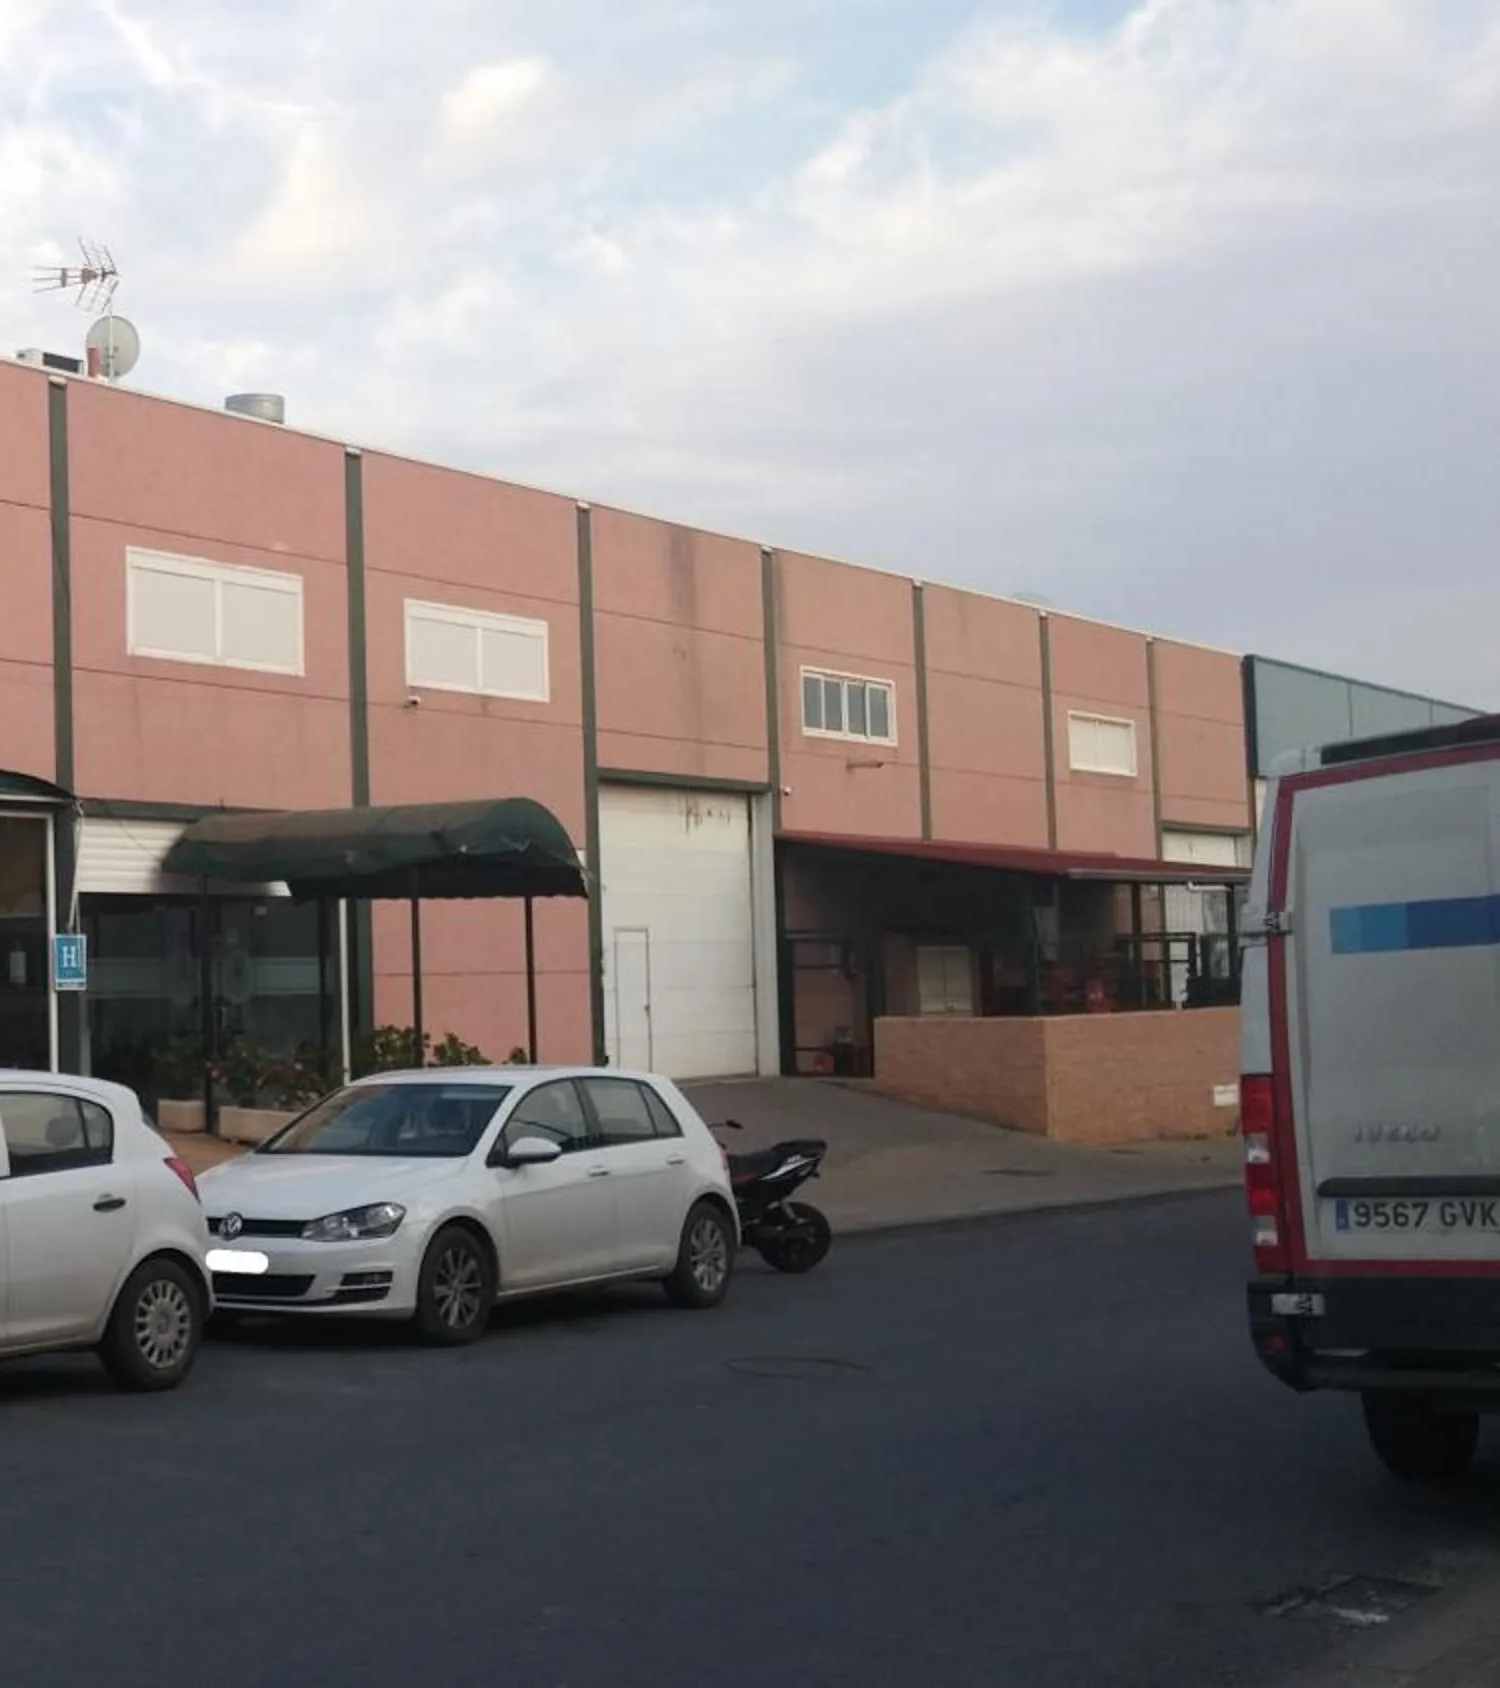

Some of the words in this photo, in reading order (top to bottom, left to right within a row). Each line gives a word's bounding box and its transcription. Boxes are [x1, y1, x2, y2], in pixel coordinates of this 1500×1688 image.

[62, 945, 77, 968] H
[1354, 1202, 1429, 1228] 9567
[1440, 1201, 1498, 1228] GVK
